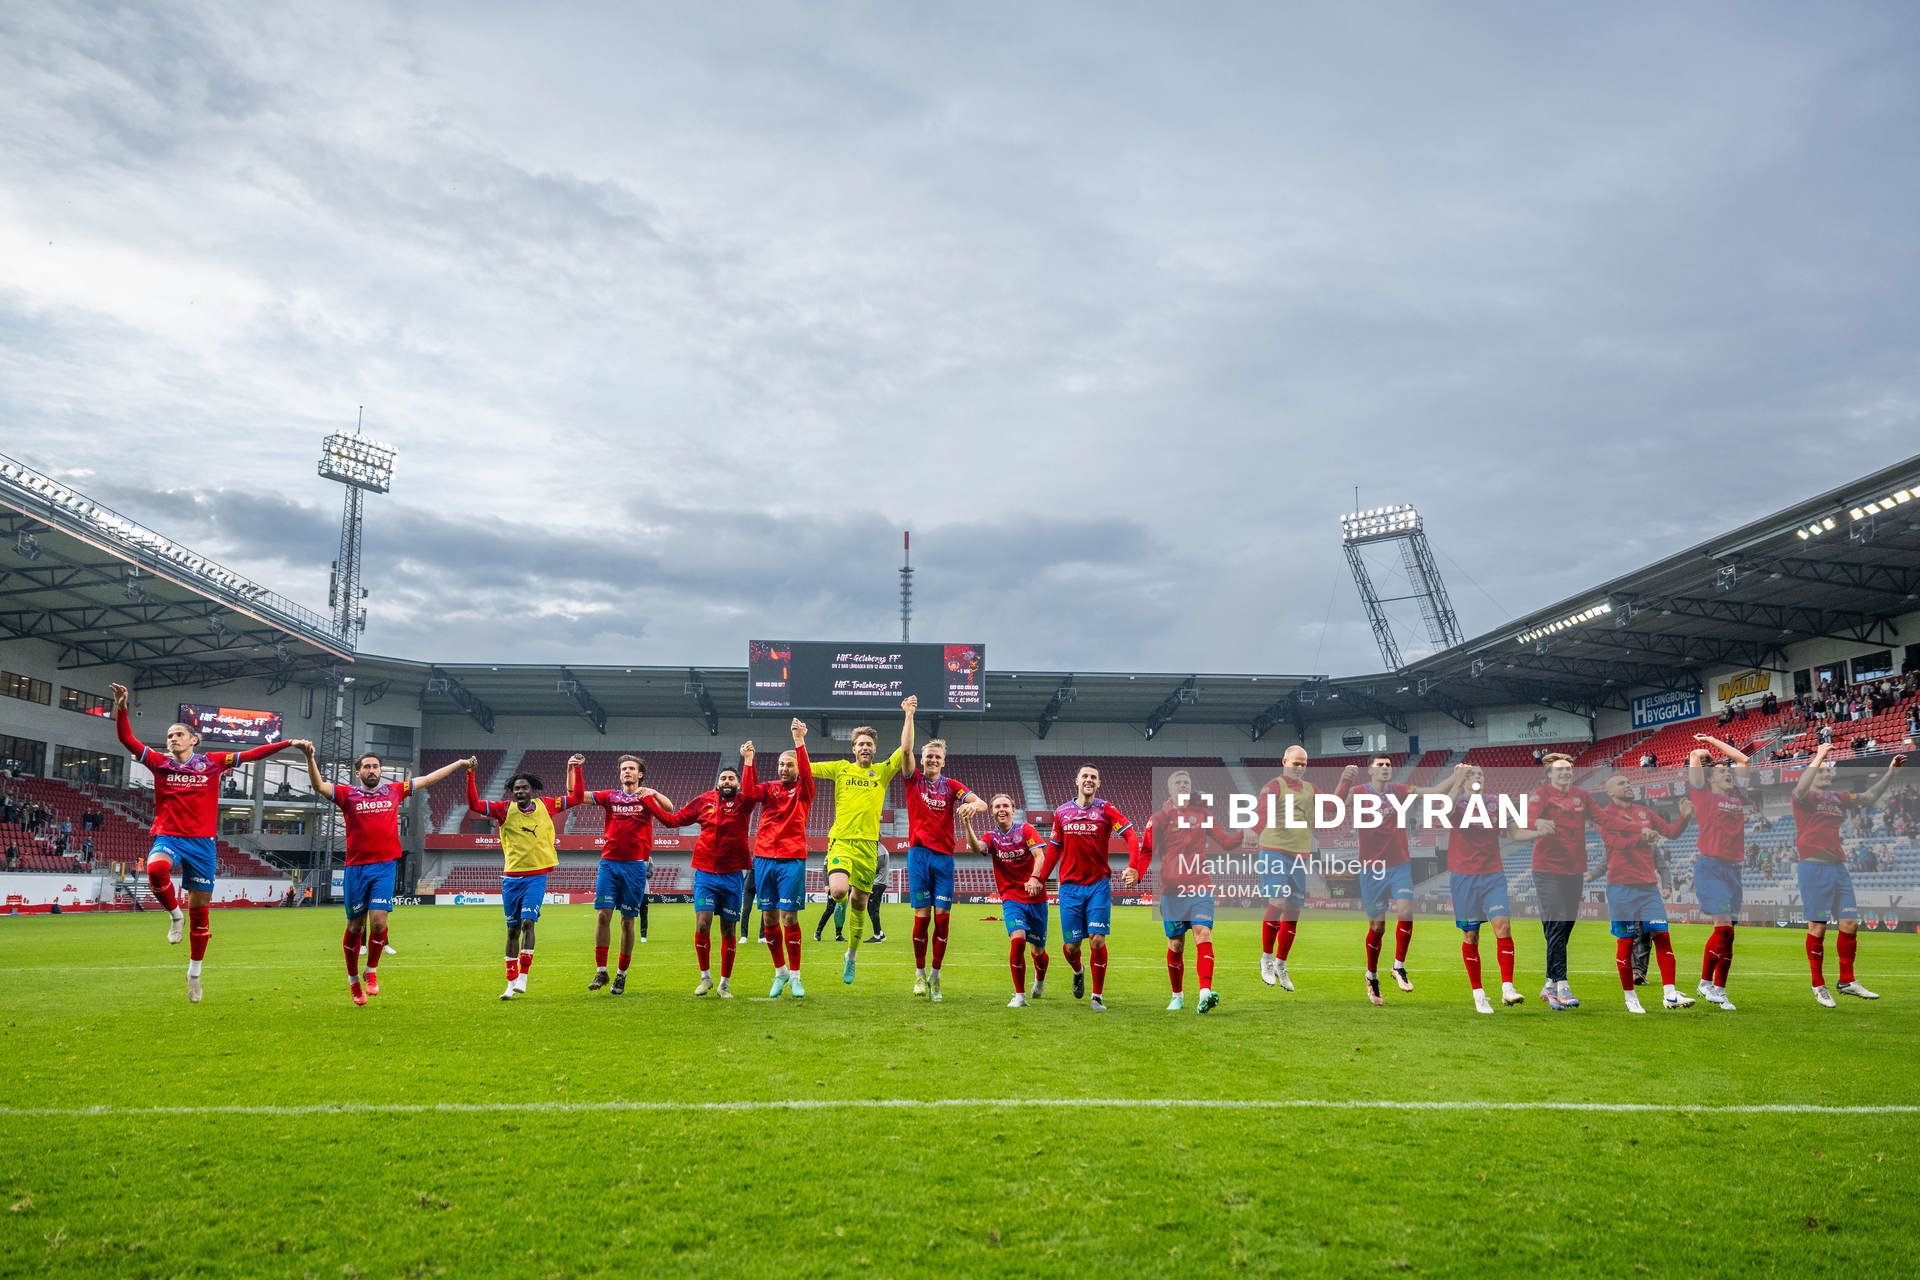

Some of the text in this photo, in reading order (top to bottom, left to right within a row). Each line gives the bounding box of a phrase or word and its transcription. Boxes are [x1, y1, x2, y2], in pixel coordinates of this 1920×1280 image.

[1718, 671, 1771, 704] WALLIN
[1647, 699, 1696, 723] BYGGPLÅT
[167, 773, 196, 783] akea
[845, 777, 869, 787] akea
[356, 800, 383, 811] akea
[475, 836, 493, 844] akea
[654, 837, 672, 845] akea
